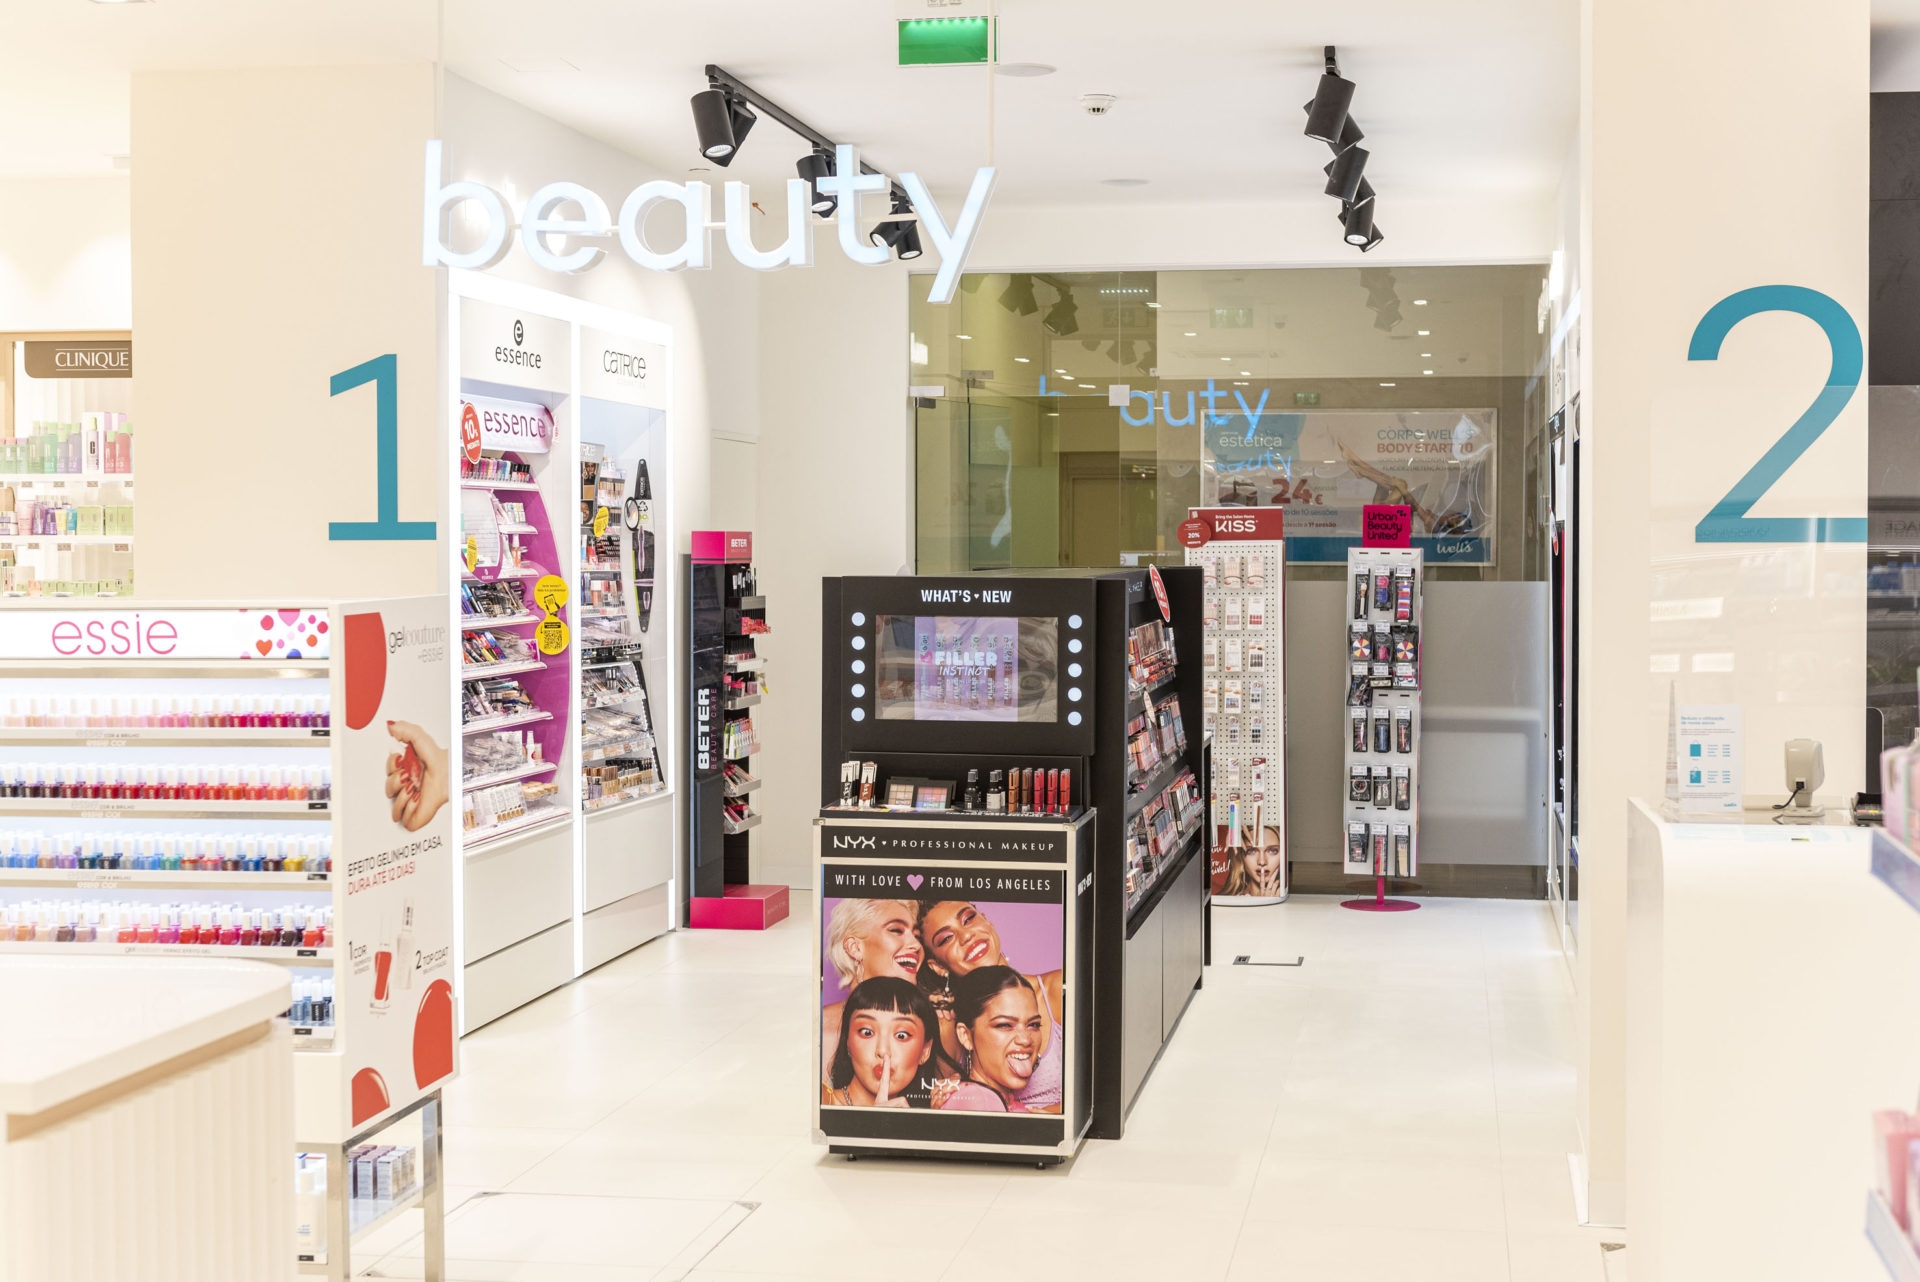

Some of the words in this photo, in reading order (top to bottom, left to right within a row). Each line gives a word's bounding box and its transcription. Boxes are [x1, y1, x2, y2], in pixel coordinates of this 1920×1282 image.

[422, 139, 999, 304] beauty
[55, 351, 129, 369] CLINIQUE
[495, 346, 542, 369] essence
[1687, 285, 1868, 543] 2
[483, 410, 546, 438] essence
[1377, 429, 1424, 440] CORPO
[328, 354, 437, 540] 1
[1377, 442, 1413, 454] BODY
[1368, 512, 1398, 521] Urban
[1215, 520, 1256, 533] KISS
[1368, 521, 1402, 533] Beauty
[1368, 531, 1398, 540] United
[921, 589, 971, 603] WHAT'S
[982, 590, 1012, 603] NEW
[52, 613, 178, 655] essie
[935, 651, 998, 666] FILLER
[940, 665, 990, 676] INSTINCT
[697, 688, 710, 769] BETER
[833, 835, 876, 849] NYX
[893, 839, 993, 850] PROFESSIONAL
[1001, 841, 1055, 851] MAKEUP
[348, 856, 375, 877] EFEITO
[376, 845, 410, 867] GELINHO
[348, 877, 370, 896] DURA
[388, 868, 396, 881] 12
[835, 874, 866, 886] WITH
[872, 875, 901, 887] LOVE
[930, 876, 963, 889] FROM
[969, 877, 991, 889] LOS
[997, 878, 1051, 891] ANGELES
[921, 1078, 960, 1090] NYX
